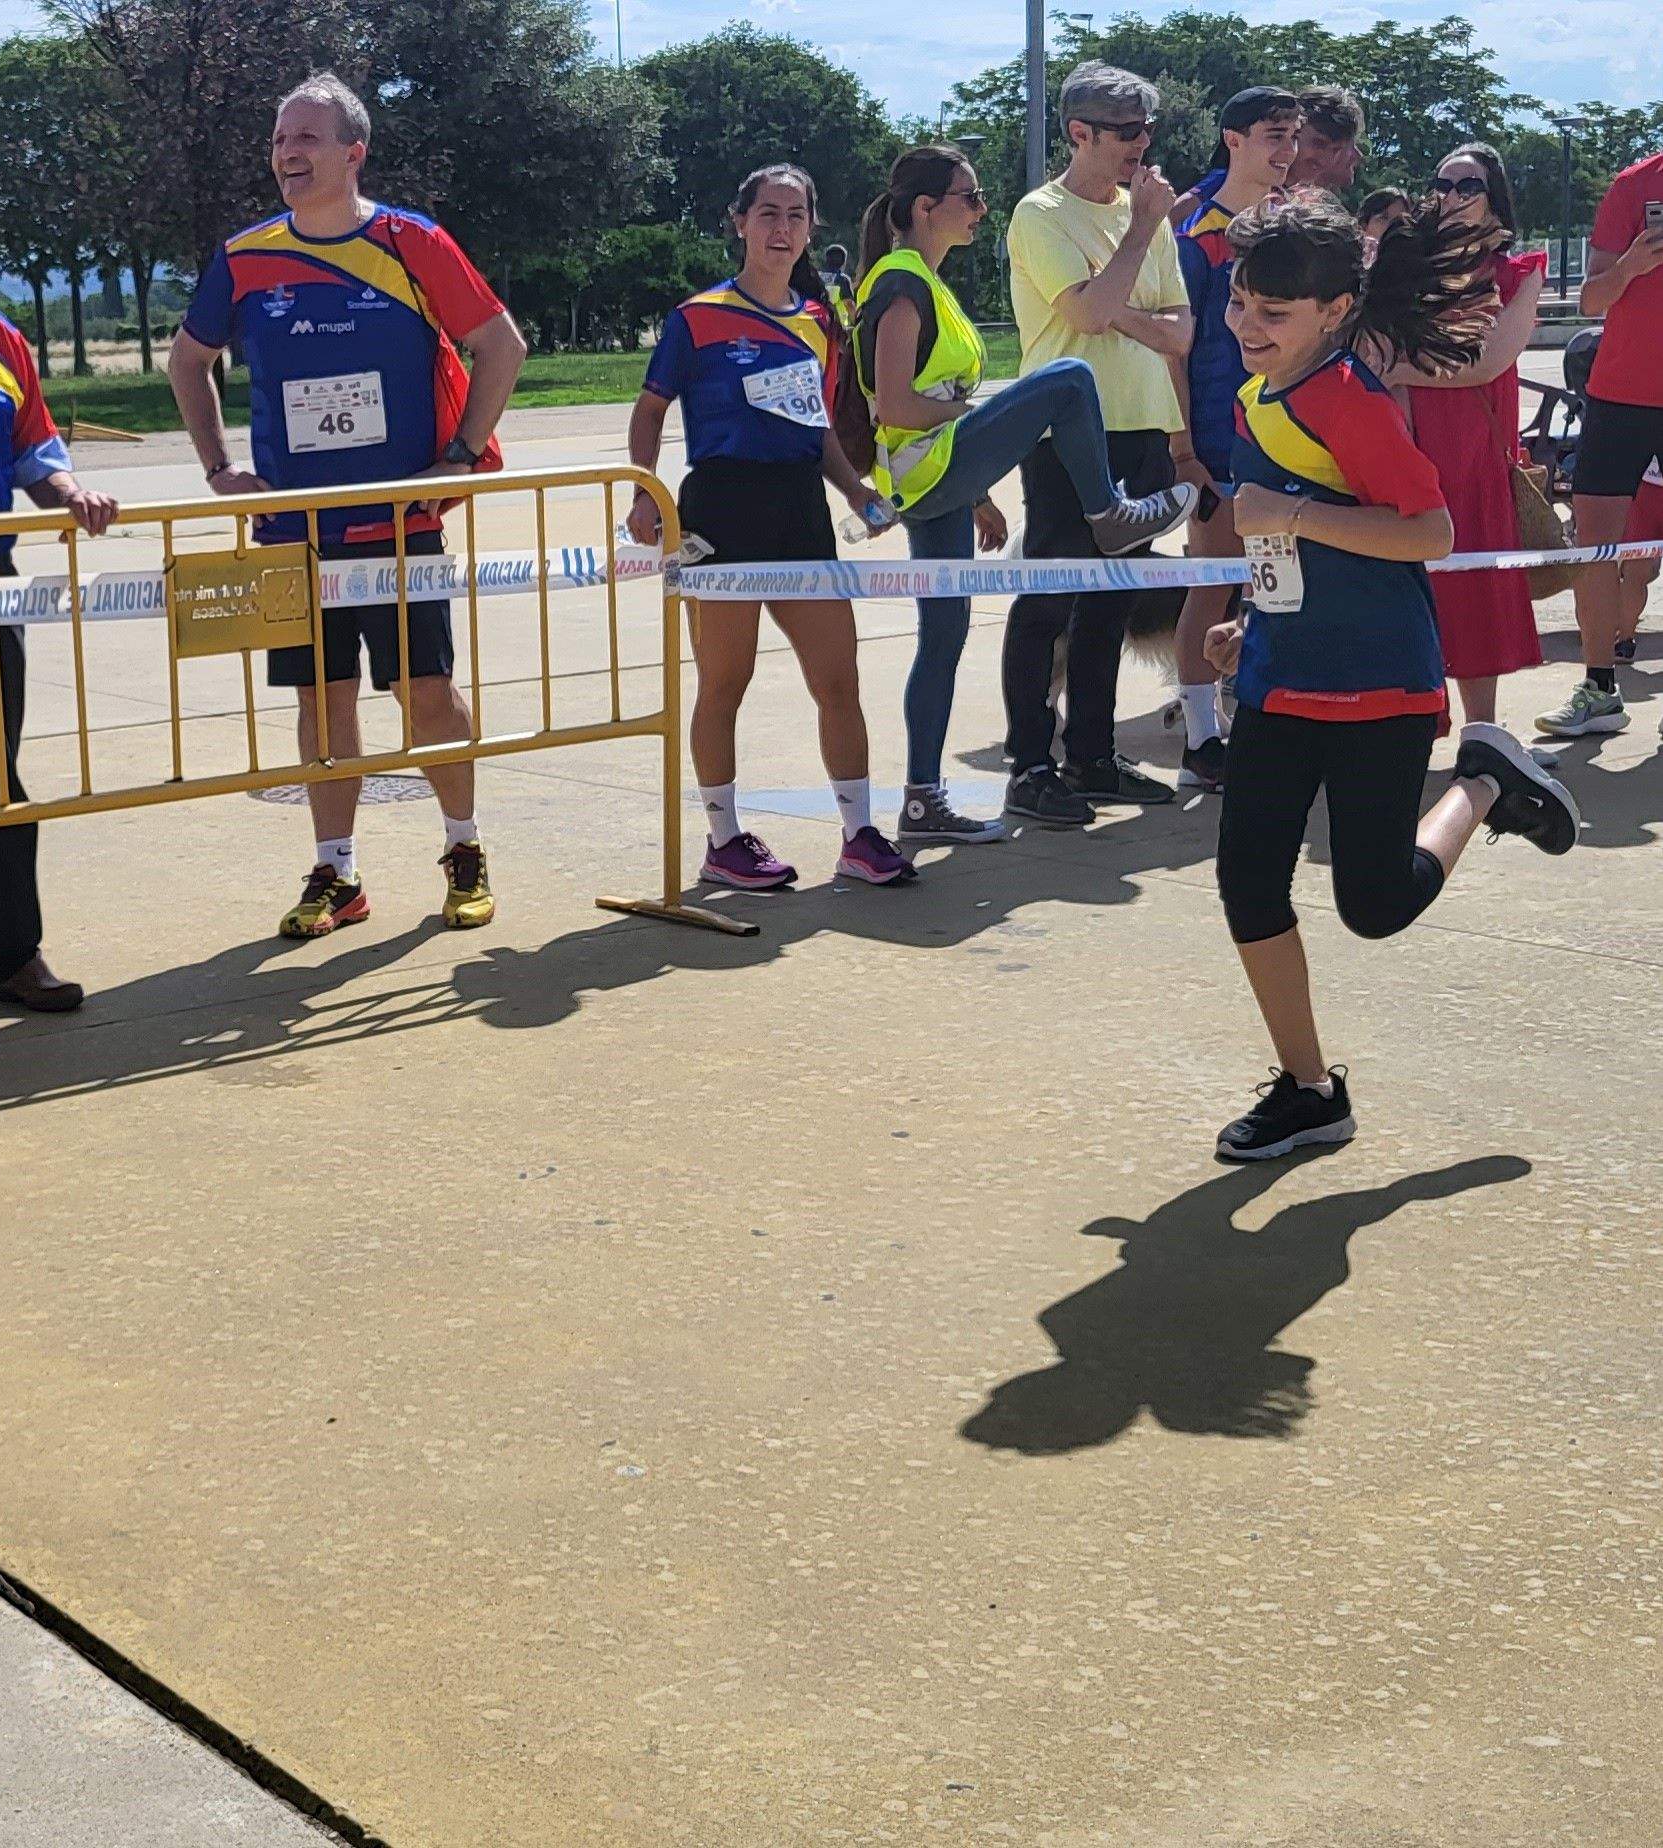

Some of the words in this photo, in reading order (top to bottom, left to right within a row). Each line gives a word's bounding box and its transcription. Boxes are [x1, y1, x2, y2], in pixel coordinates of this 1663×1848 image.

[347, 301, 389, 310] Santander
[317, 320, 355, 335] mupol
[318, 412, 355, 435] 46
